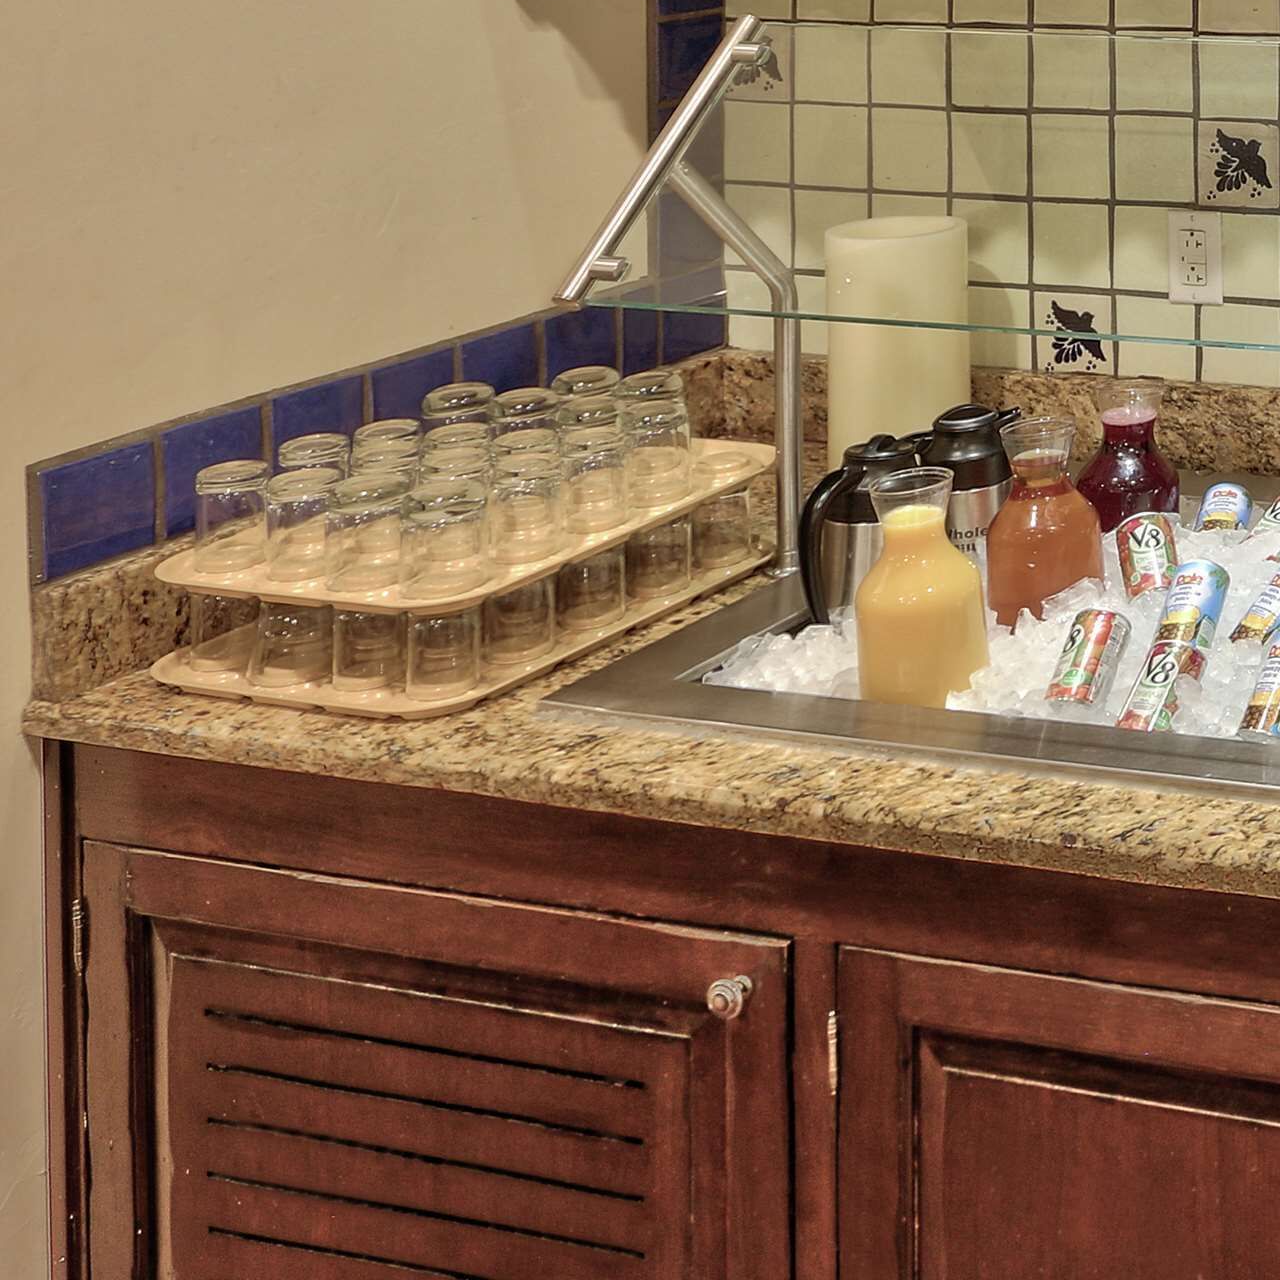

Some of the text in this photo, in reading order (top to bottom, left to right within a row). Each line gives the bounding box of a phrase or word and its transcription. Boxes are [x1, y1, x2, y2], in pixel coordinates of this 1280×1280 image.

[948, 527, 990, 540] hole
[1129, 524, 1160, 548] V8
[1146, 651, 1176, 684] V8
